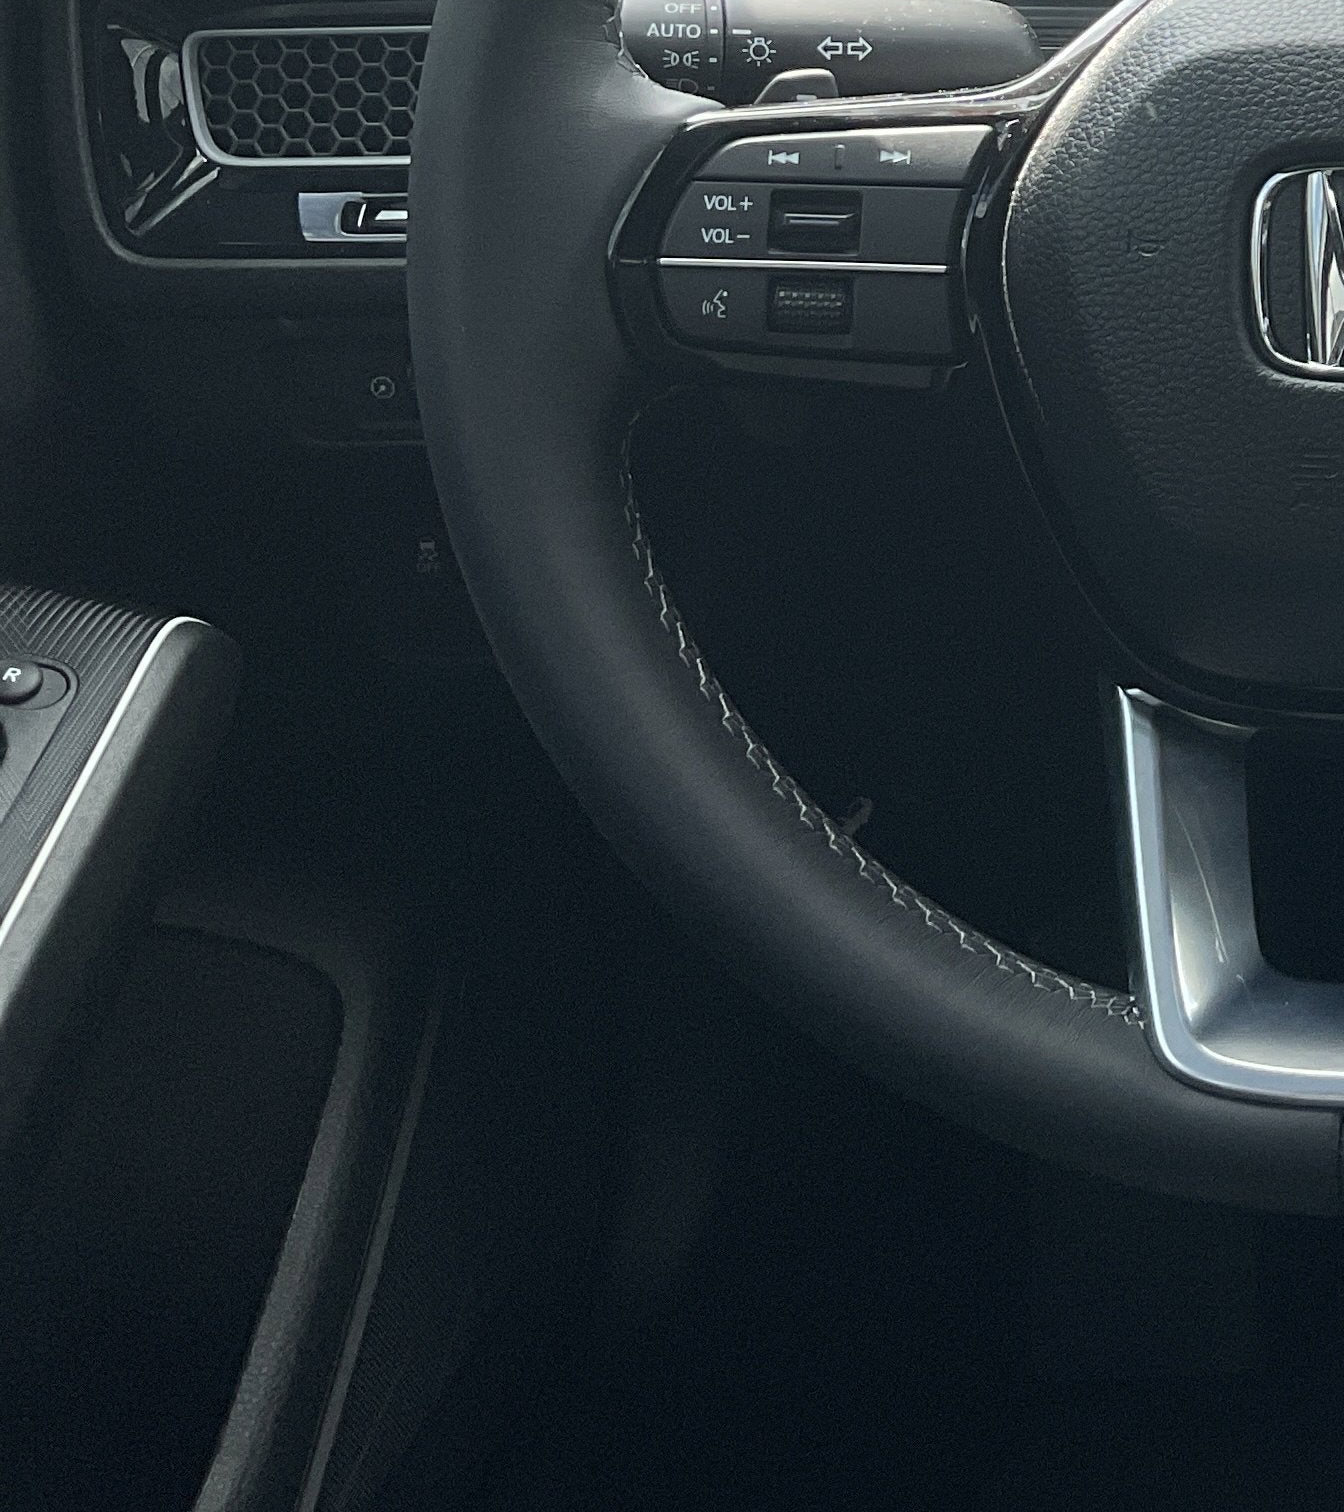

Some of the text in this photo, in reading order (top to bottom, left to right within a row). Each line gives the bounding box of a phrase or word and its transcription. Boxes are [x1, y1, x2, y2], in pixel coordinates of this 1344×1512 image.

[664, 3, 702, 14] OFF
[646, 24, 702, 38] AUTO
[2, 666, 22, 683] R
